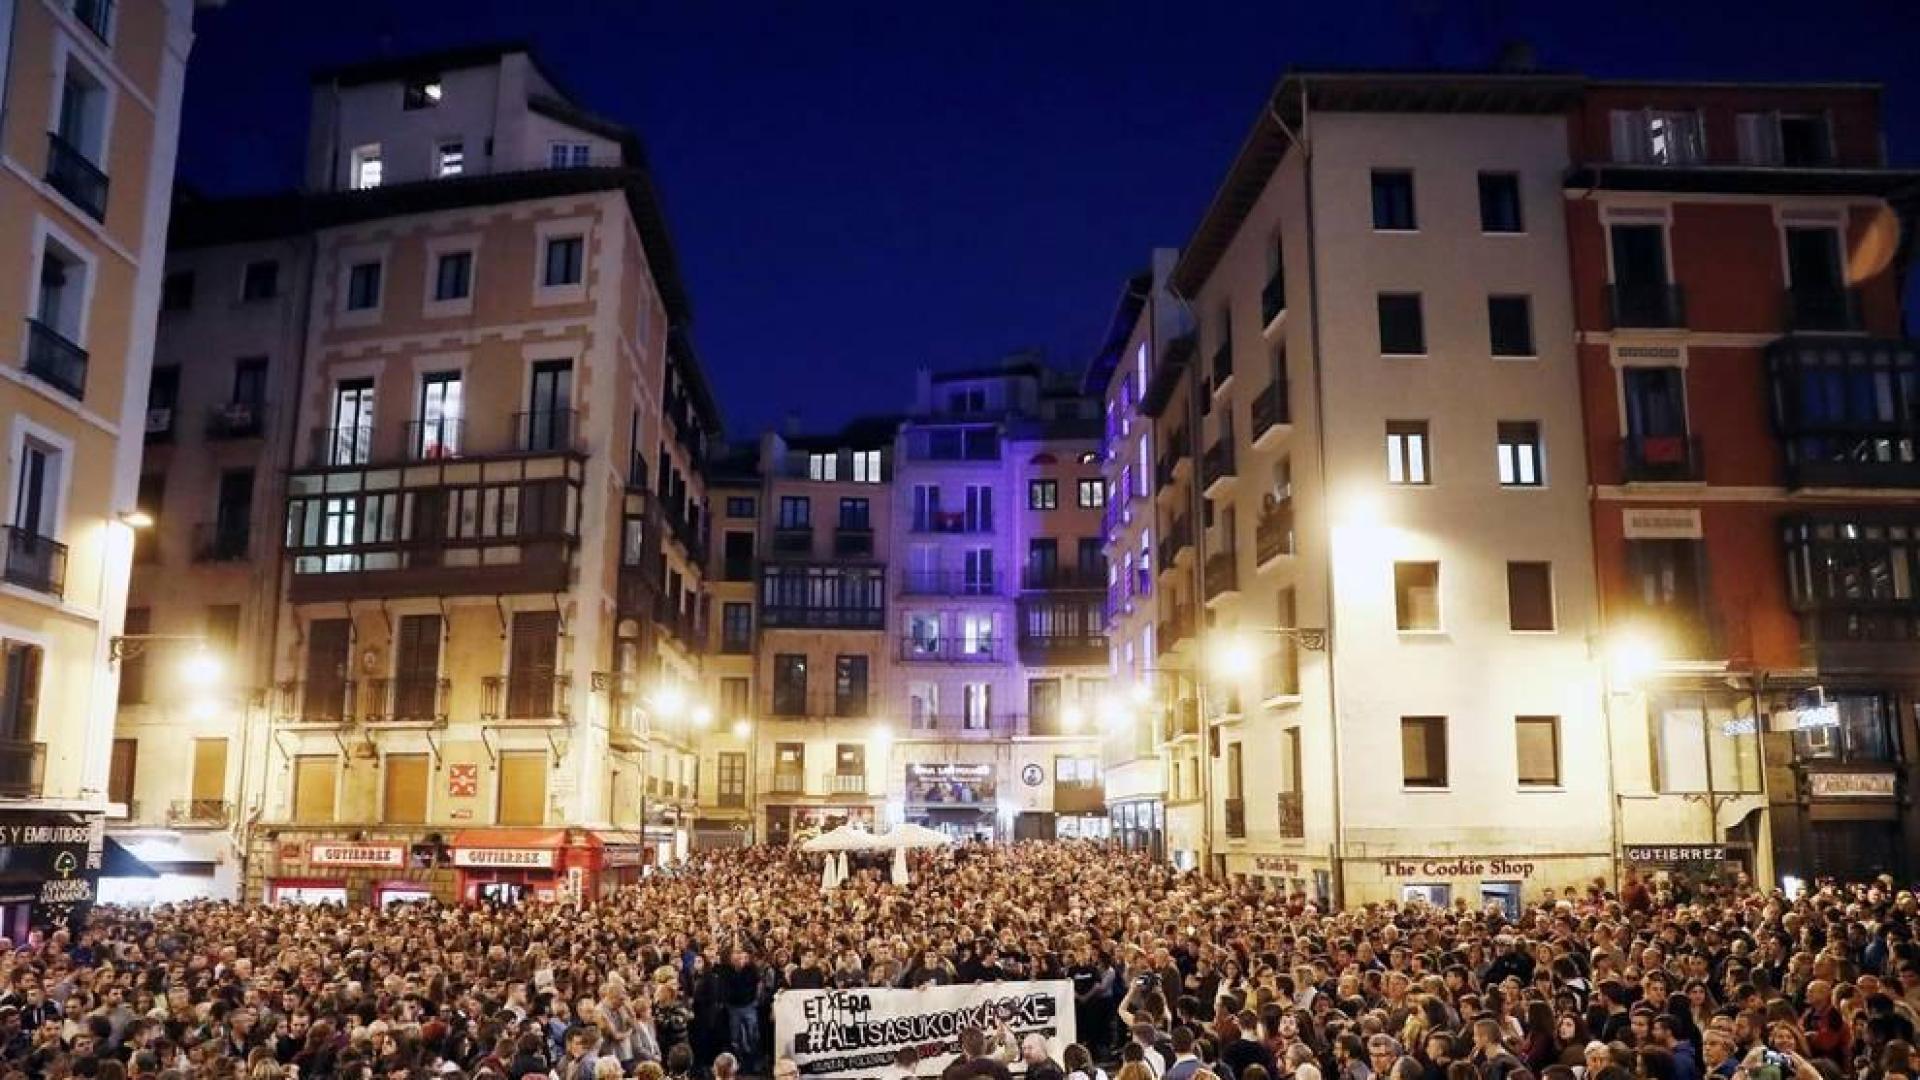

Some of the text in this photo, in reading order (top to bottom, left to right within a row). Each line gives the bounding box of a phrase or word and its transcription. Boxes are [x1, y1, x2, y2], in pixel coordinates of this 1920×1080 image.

[11, 827, 20, 843] Y
[325, 848, 392, 861] GUTIERREZ
[468, 851, 541, 864] GUTIERREZ
[1628, 848, 1724, 861] GUTIERREZ
[1381, 857, 1535, 878] The Cookie Shop
[804, 992, 872, 1019] ETXERA
